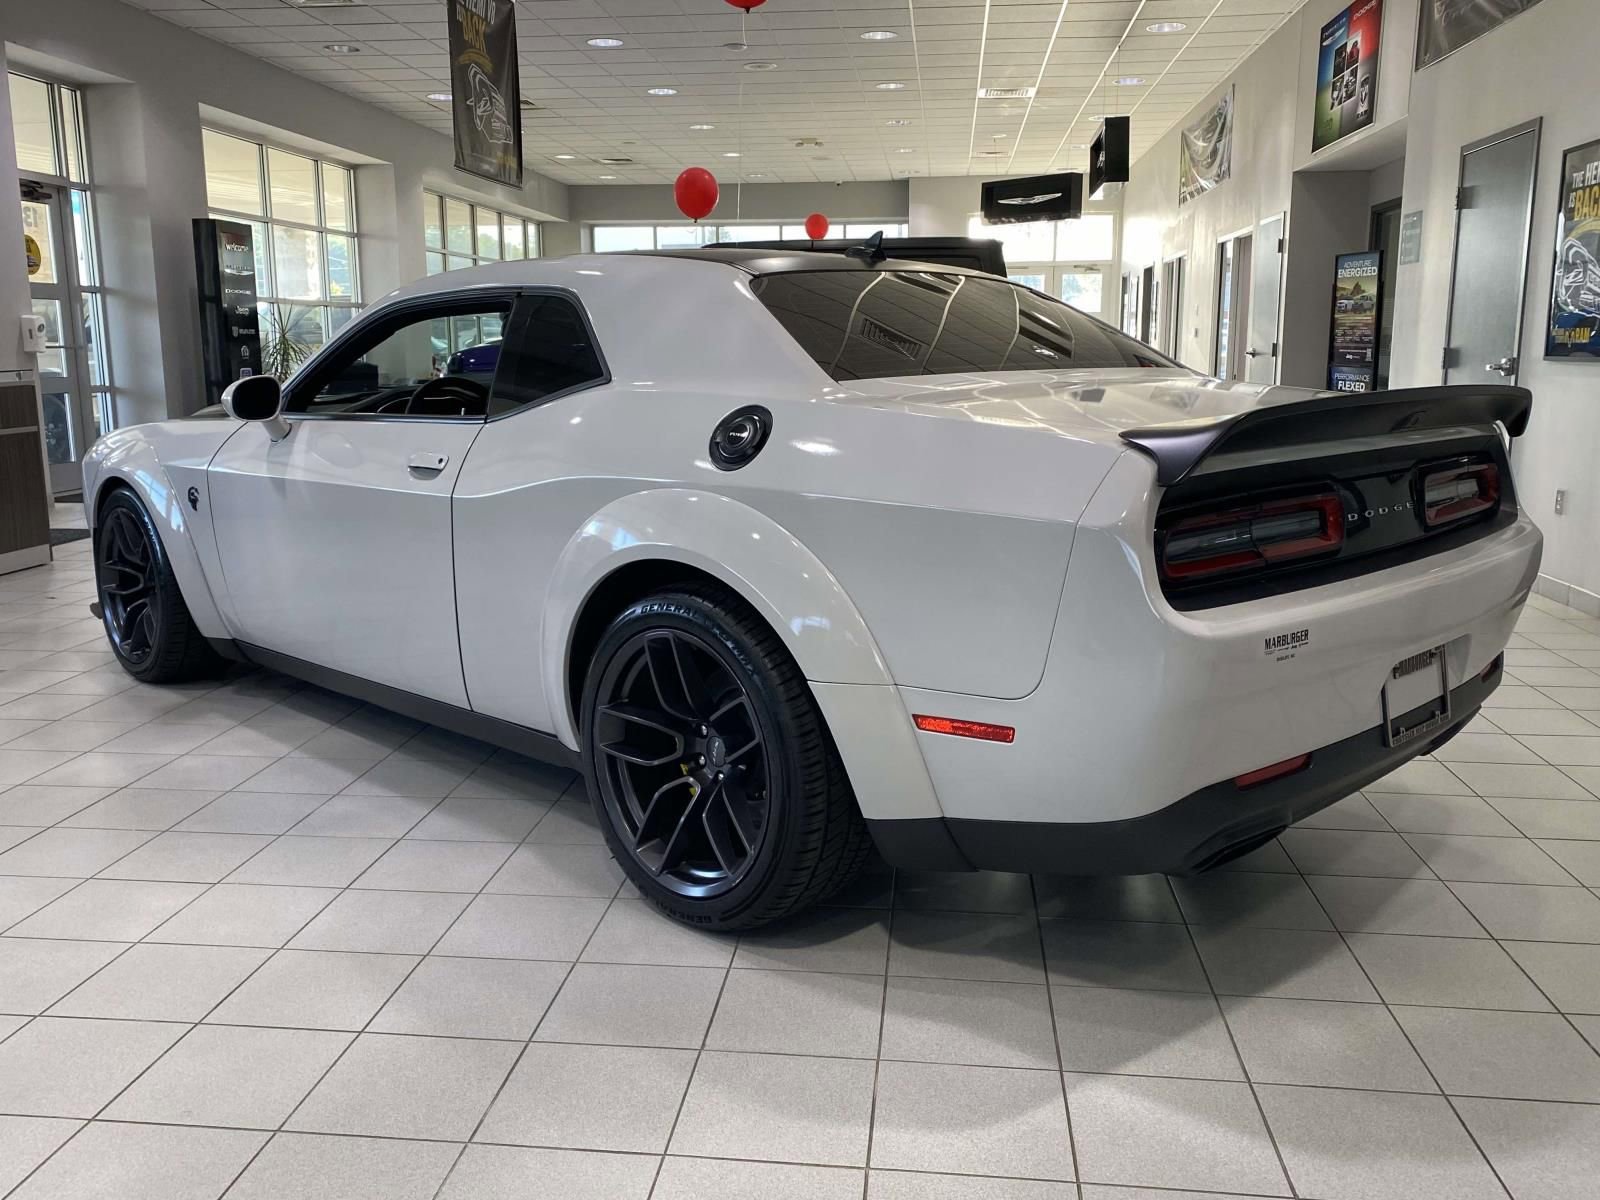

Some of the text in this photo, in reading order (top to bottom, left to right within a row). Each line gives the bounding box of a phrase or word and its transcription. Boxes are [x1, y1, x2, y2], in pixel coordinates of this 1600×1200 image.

[1572, 171, 1585, 189] THE
[1574, 185, 1600, 222] BAC
[1338, 266, 1379, 278] ENERGIZED
[1335, 372, 1370, 382] PERFORMANCE
[1338, 380, 1366, 392] FLEXED
[1347, 501, 1413, 521] DODGE
[640, 602, 700, 618] GENERAL
[1264, 629, 1309, 650] MARBURGER
